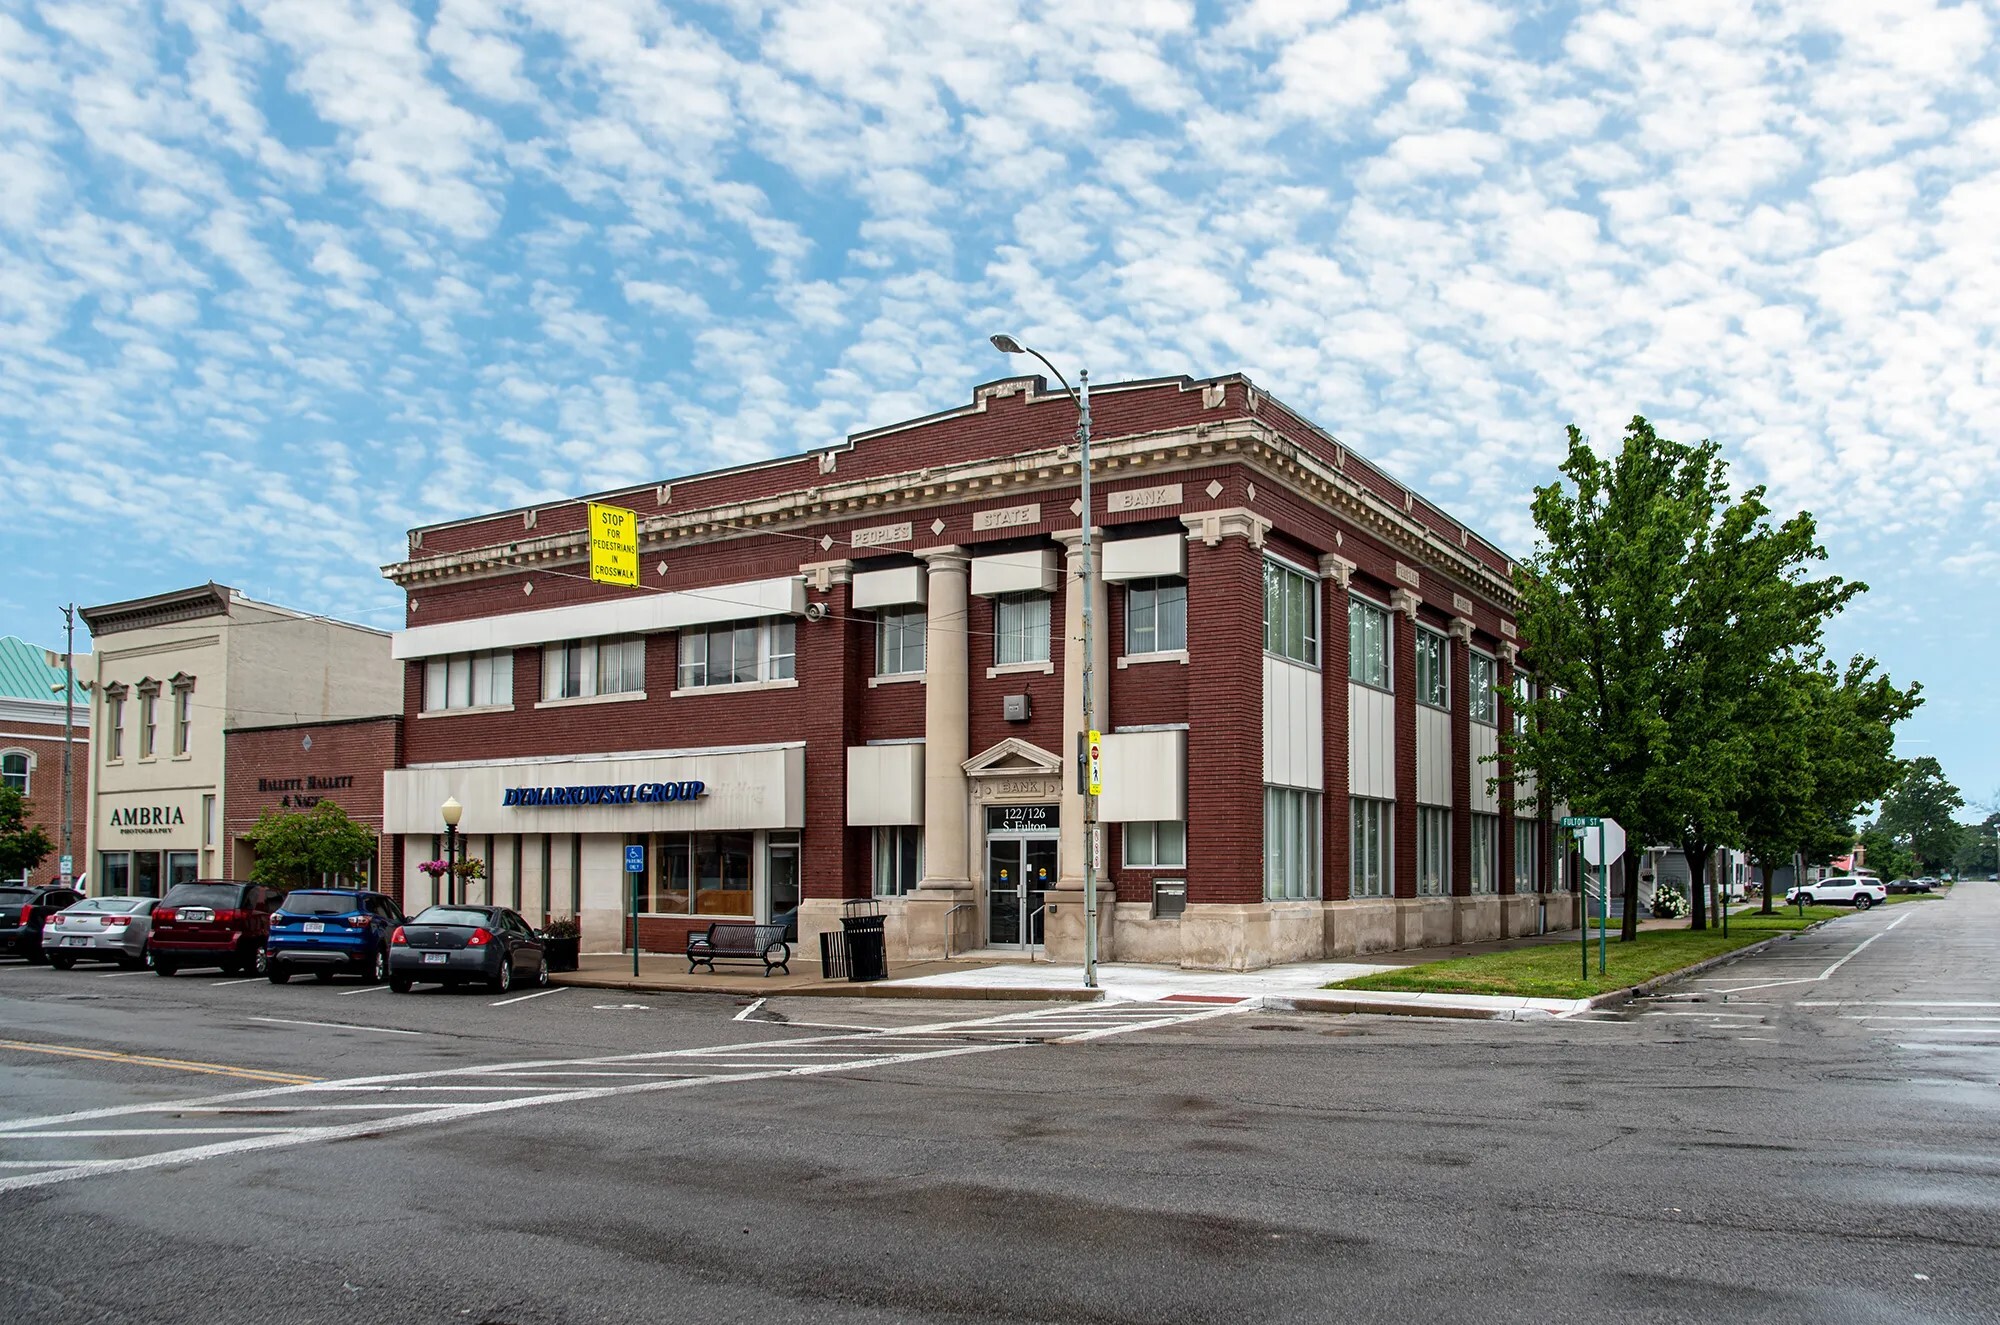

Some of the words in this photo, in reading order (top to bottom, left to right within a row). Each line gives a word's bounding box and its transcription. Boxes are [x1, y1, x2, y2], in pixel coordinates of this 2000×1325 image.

[602, 512, 624, 526] STOP
[854, 526, 910, 545] PEOPLES
[984, 508, 1030, 527] STATE
[1123, 489, 1166, 508] BANK
[607, 528, 621, 539] FOR
[593, 539, 635, 554] PEDESTRIANS
[612, 555, 618, 563] IN
[595, 565, 635, 579] CROSSWALK
[502, 784, 636, 807] DYMARKOWSKI
[636, 780, 705, 803] GROUP
[1003, 781, 1038, 793] BANK
[110, 806, 185, 826] AMBRIA
[1005, 807, 1046, 820] 122/126
[1002, 820, 1012, 832] S.
[1015, 820, 1047, 832] Fulton
[1563, 817, 1586, 826] FULTON
[1590, 817, 1598, 826] ST
